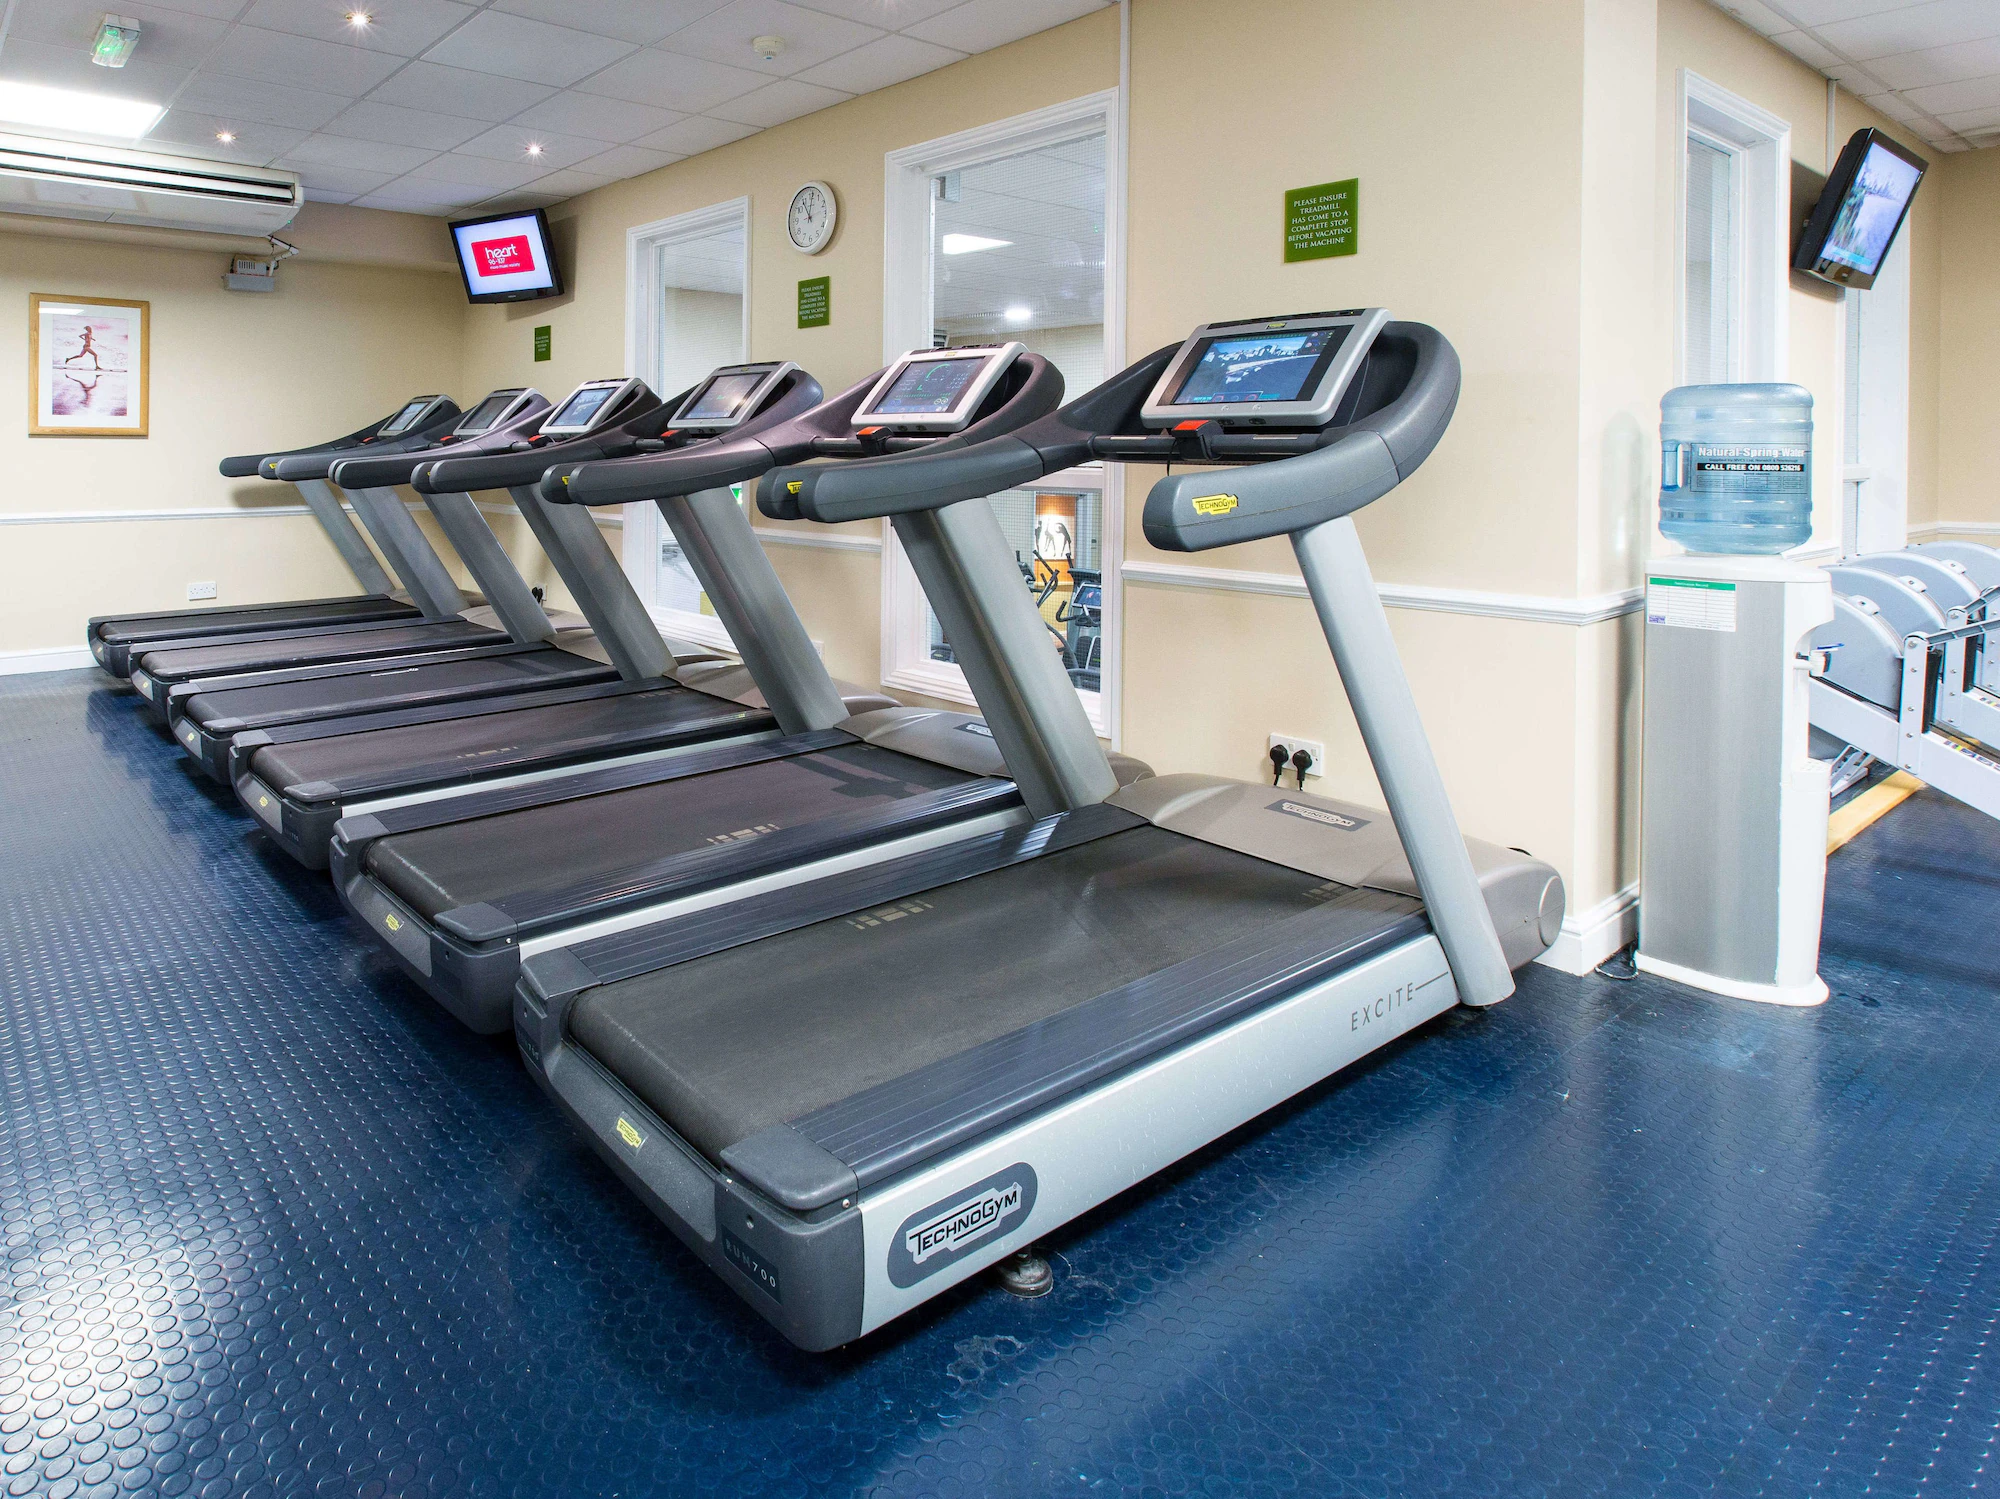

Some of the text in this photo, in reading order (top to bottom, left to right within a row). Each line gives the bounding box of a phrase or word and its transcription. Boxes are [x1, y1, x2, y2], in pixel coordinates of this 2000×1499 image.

[1294, 192, 1347, 207] PLEASE ENSURE
[1300, 203, 1340, 214] TREADMILL
[1308, 213, 1329, 222] COME
[1291, 219, 1348, 233] COMPLETE STOP
[1288, 227, 1352, 242] BEFORE VACATING
[1310, 237, 1345, 247] MACHINE
[485, 244, 518, 259] heart
[1699, 447, 1805, 458] Natural Spring Water
[1195, 498, 1236, 511] TECHNOGYM
[1284, 804, 1351, 825] TECHNOGYM
[1352, 982, 1413, 1032] EXCITE
[909, 1190, 1017, 1256] TECHNOGYM
